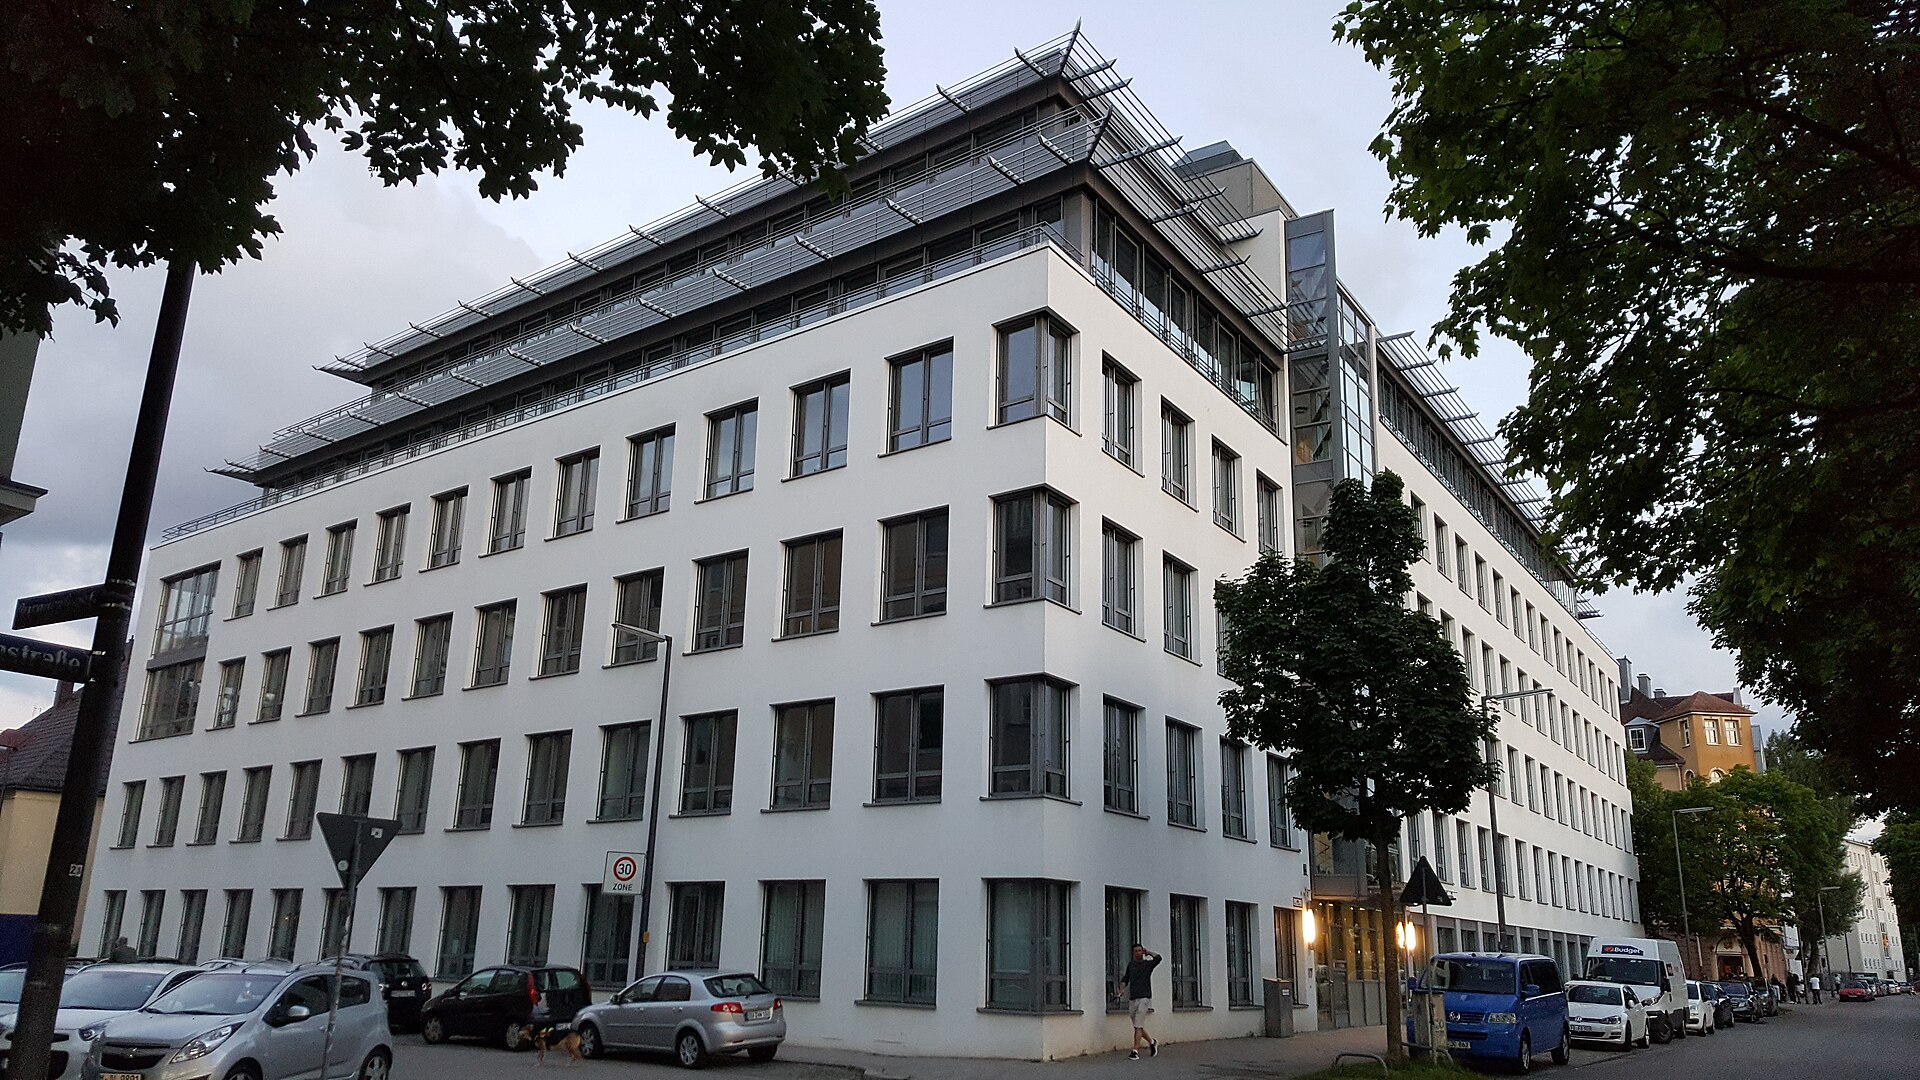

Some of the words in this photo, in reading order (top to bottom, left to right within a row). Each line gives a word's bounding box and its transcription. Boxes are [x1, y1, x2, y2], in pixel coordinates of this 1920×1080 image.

[618, 863, 632, 875] 30
[612, 883, 633, 891] ZONE
[1614, 946, 1640, 954] Budget
